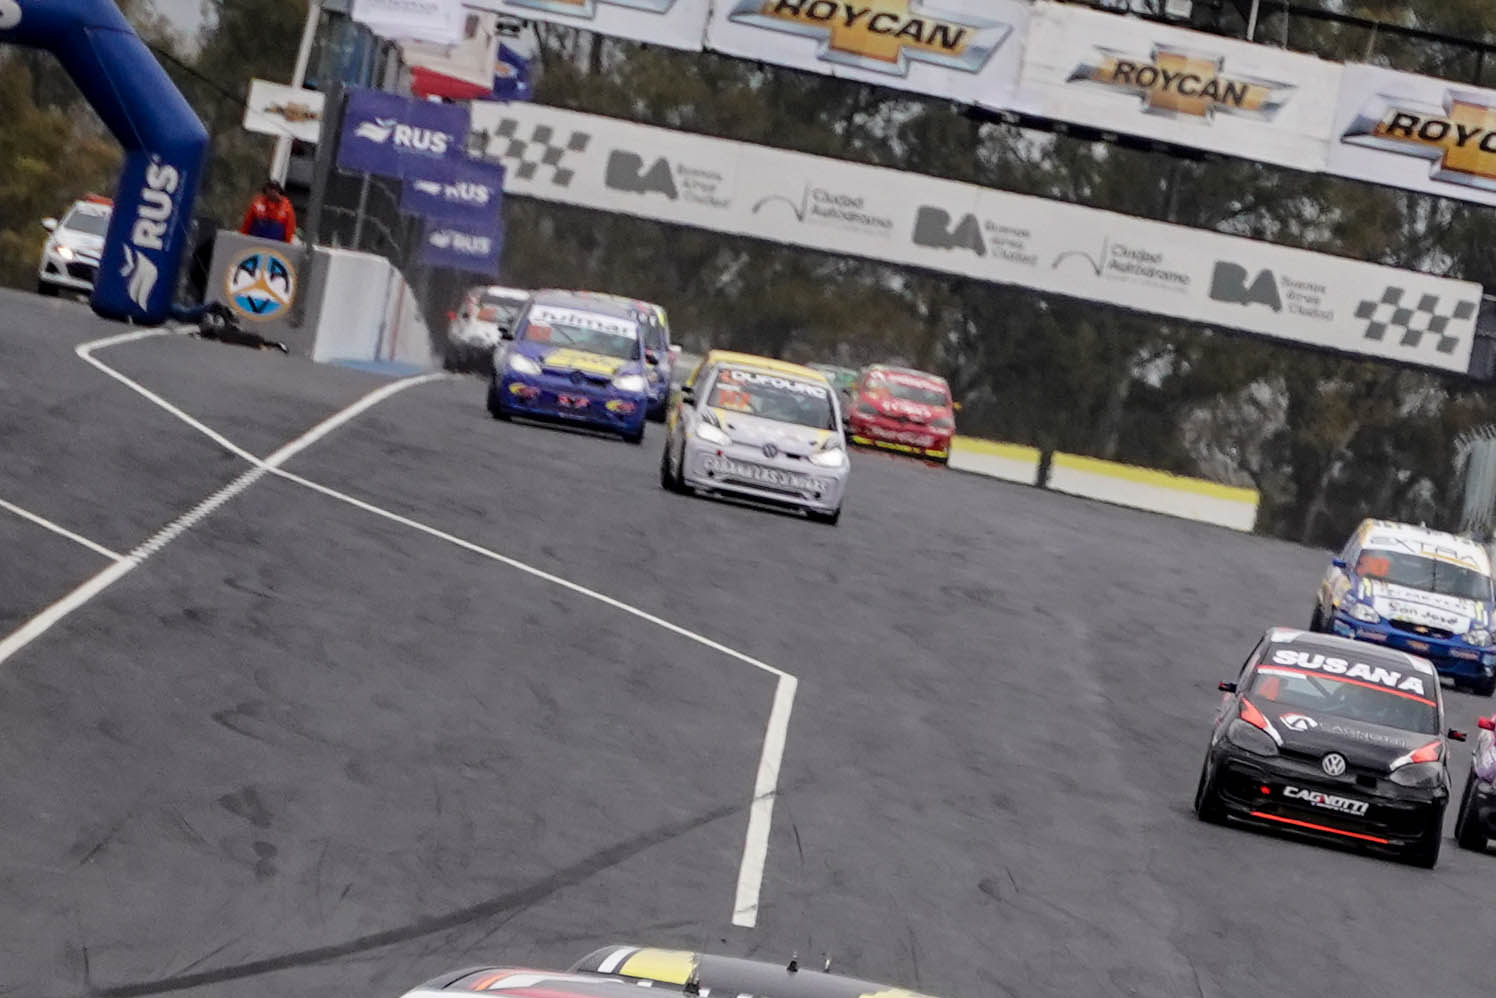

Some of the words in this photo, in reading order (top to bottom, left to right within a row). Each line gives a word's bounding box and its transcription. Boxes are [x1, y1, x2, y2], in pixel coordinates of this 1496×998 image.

[1112, 60, 1250, 106] ROYCAN
[393, 124, 448, 154] RUS
[131, 164, 180, 251] RUS
[1272, 649, 1425, 695] SUSANA
